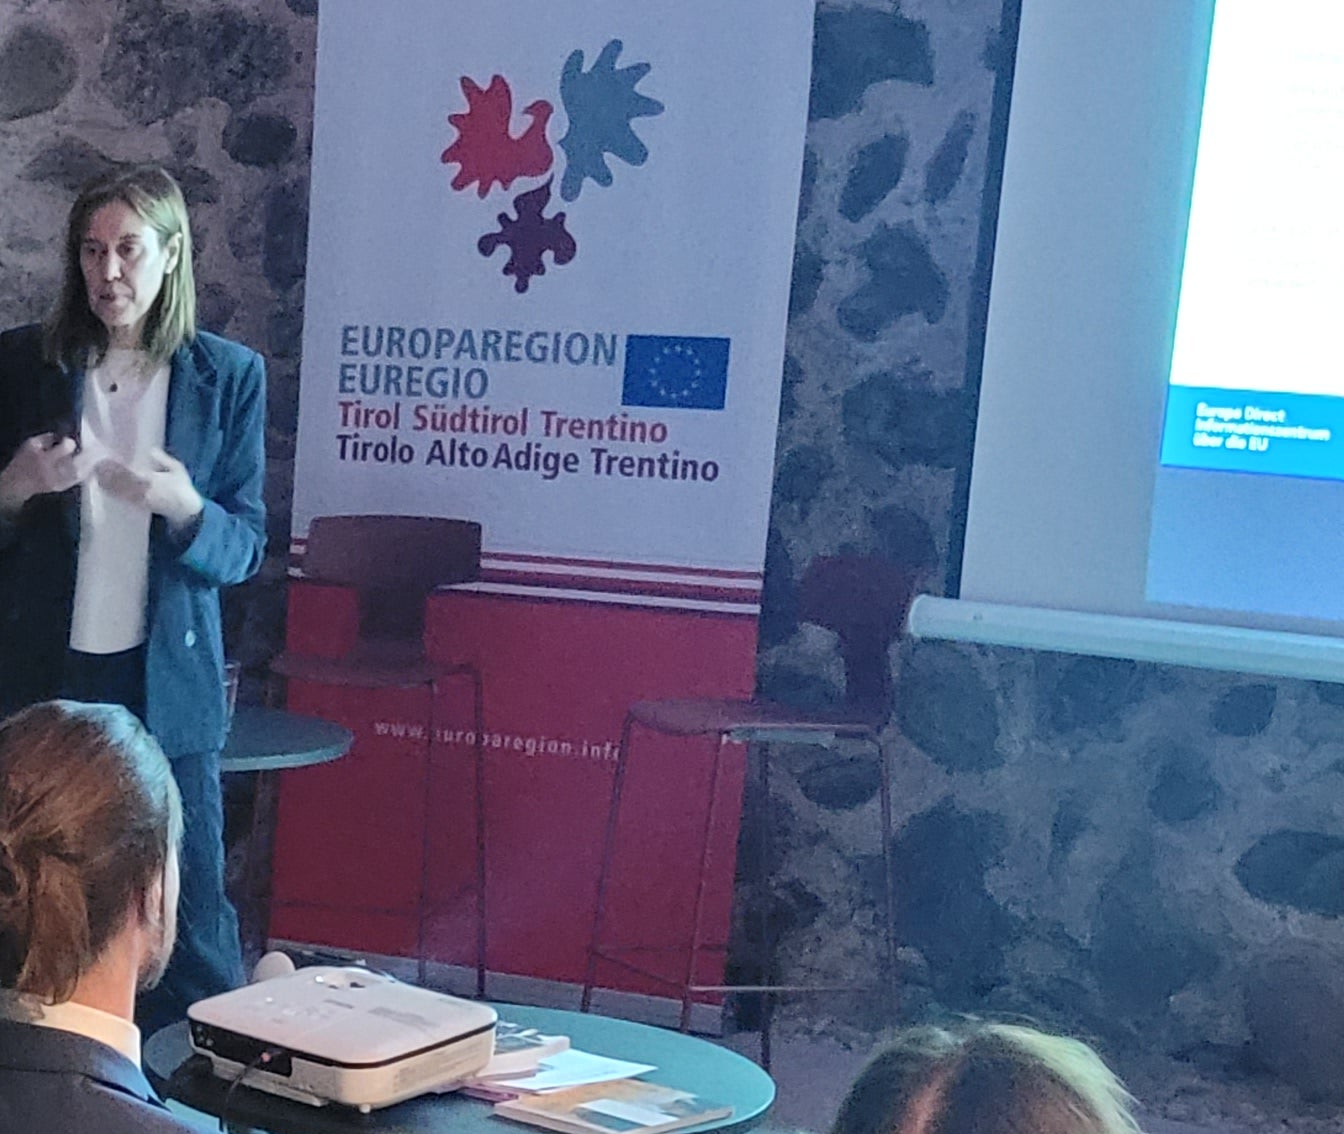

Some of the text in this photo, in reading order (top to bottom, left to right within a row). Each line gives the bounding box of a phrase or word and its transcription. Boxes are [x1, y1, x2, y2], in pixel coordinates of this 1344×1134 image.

[340, 325, 617, 366] EUROPAREGION
[338, 363, 489, 399] EUREGIO
[338, 400, 669, 444] Tirol Südtirol Trentino
[336, 434, 720, 482] Tirolo Alto Adige Trentino
